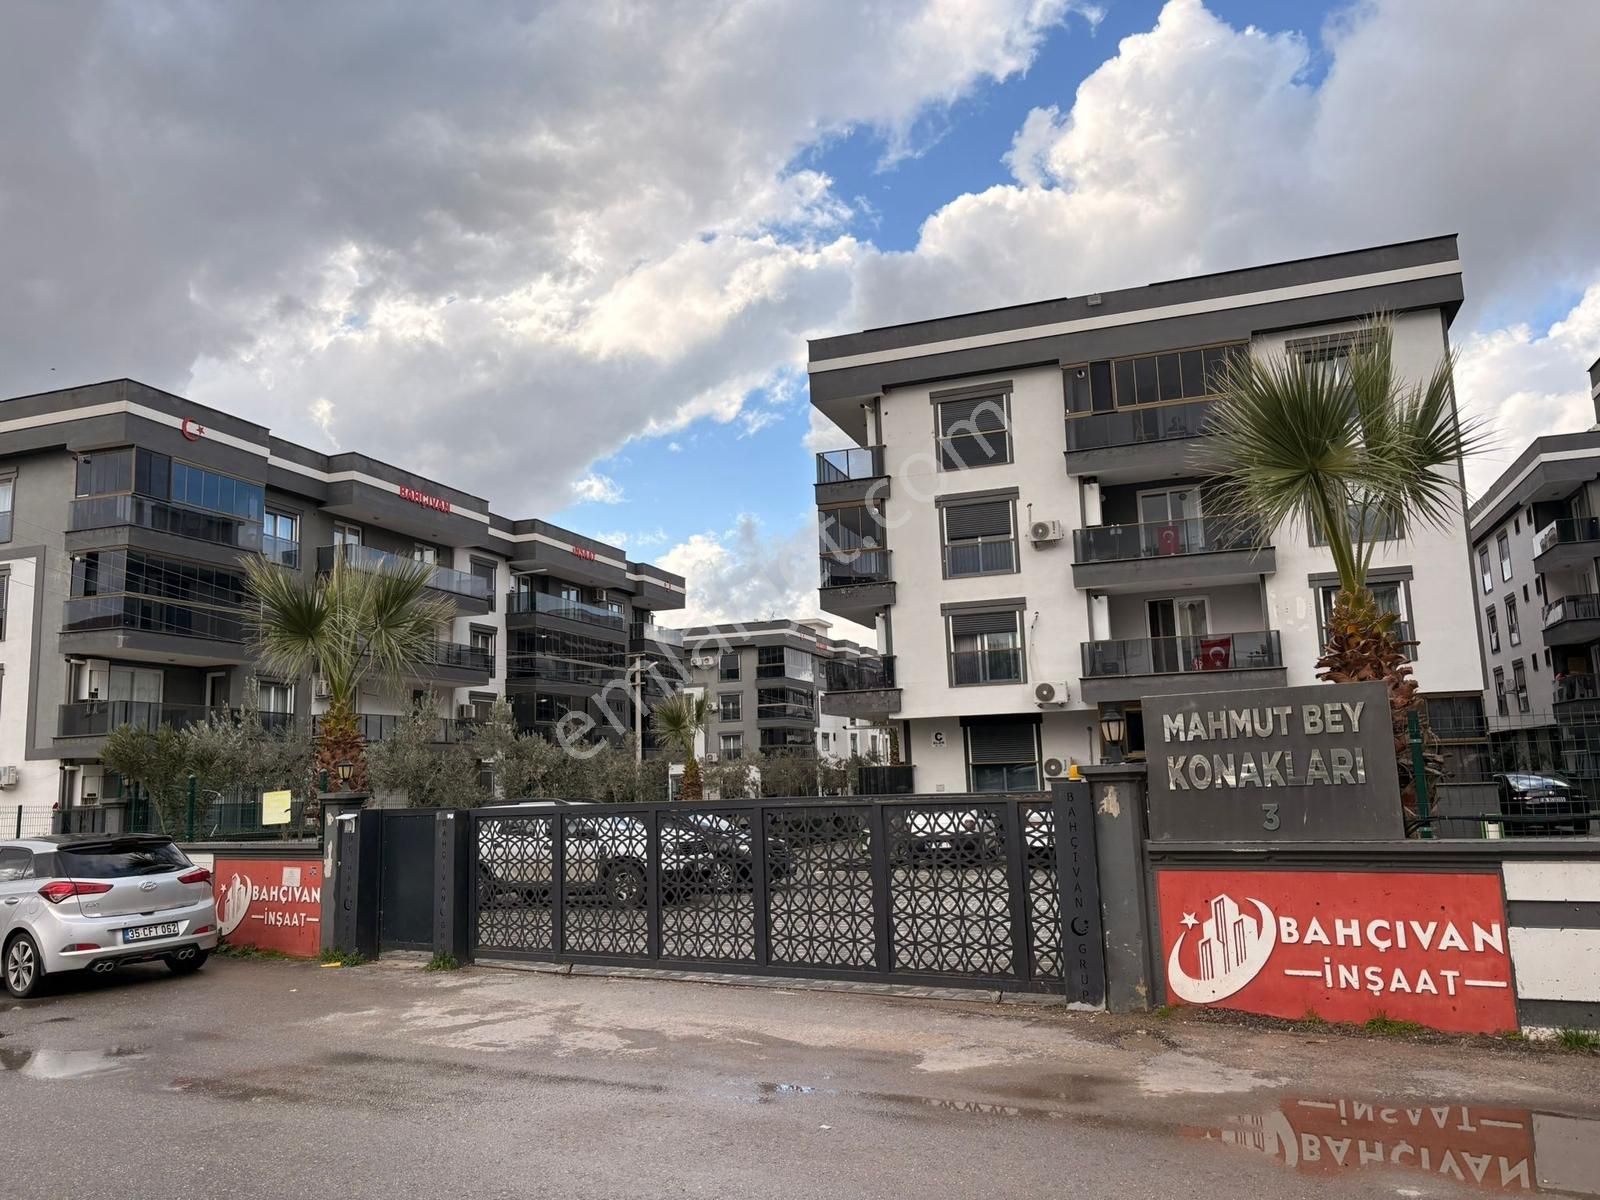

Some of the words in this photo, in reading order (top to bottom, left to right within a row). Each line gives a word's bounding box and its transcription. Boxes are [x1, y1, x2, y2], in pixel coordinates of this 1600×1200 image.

[1162, 706, 1292, 742] MAHMUT
[1302, 701, 1365, 735] BEY
[1166, 747, 1367, 790] KONAKLARI
[1262, 803, 1280, 831] 3
[252, 885, 321, 904] BAHÇIVAN
[128, 928, 140, 940] 35
[143, 926, 159, 937] CFT
[1278, 916, 1505, 954] BAHÇIVAN
[1323, 956, 1460, 996] İNŞAAT
